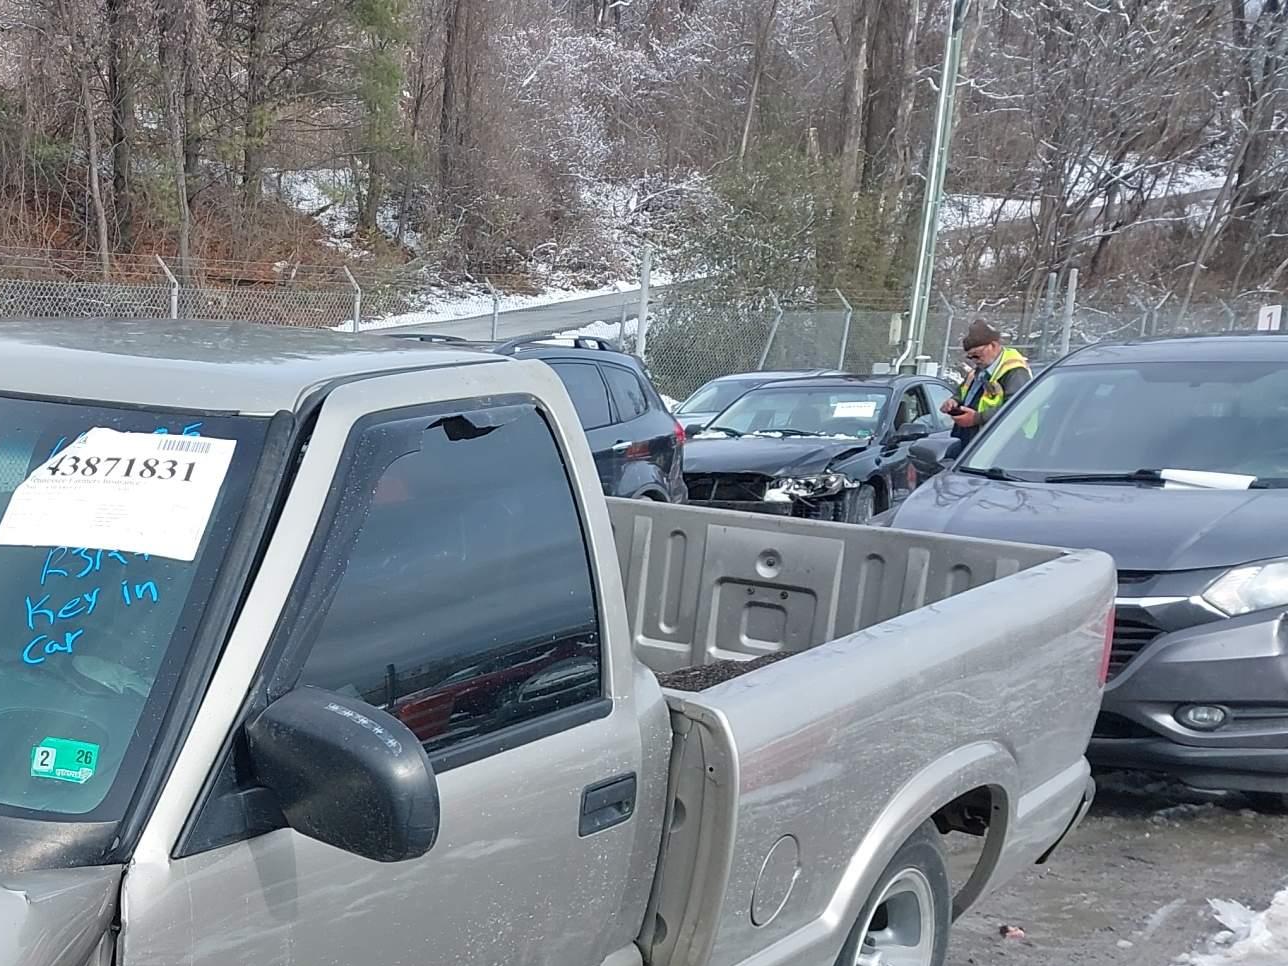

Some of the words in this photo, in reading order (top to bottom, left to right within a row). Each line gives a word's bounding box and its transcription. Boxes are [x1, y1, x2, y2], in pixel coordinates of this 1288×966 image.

[47, 454, 196, 482] 43871831
[25, 587, 100, 630] Key
[121, 580, 159, 605] in
[39, 750, 50, 767] 2
[76, 749, 93, 765] 26
